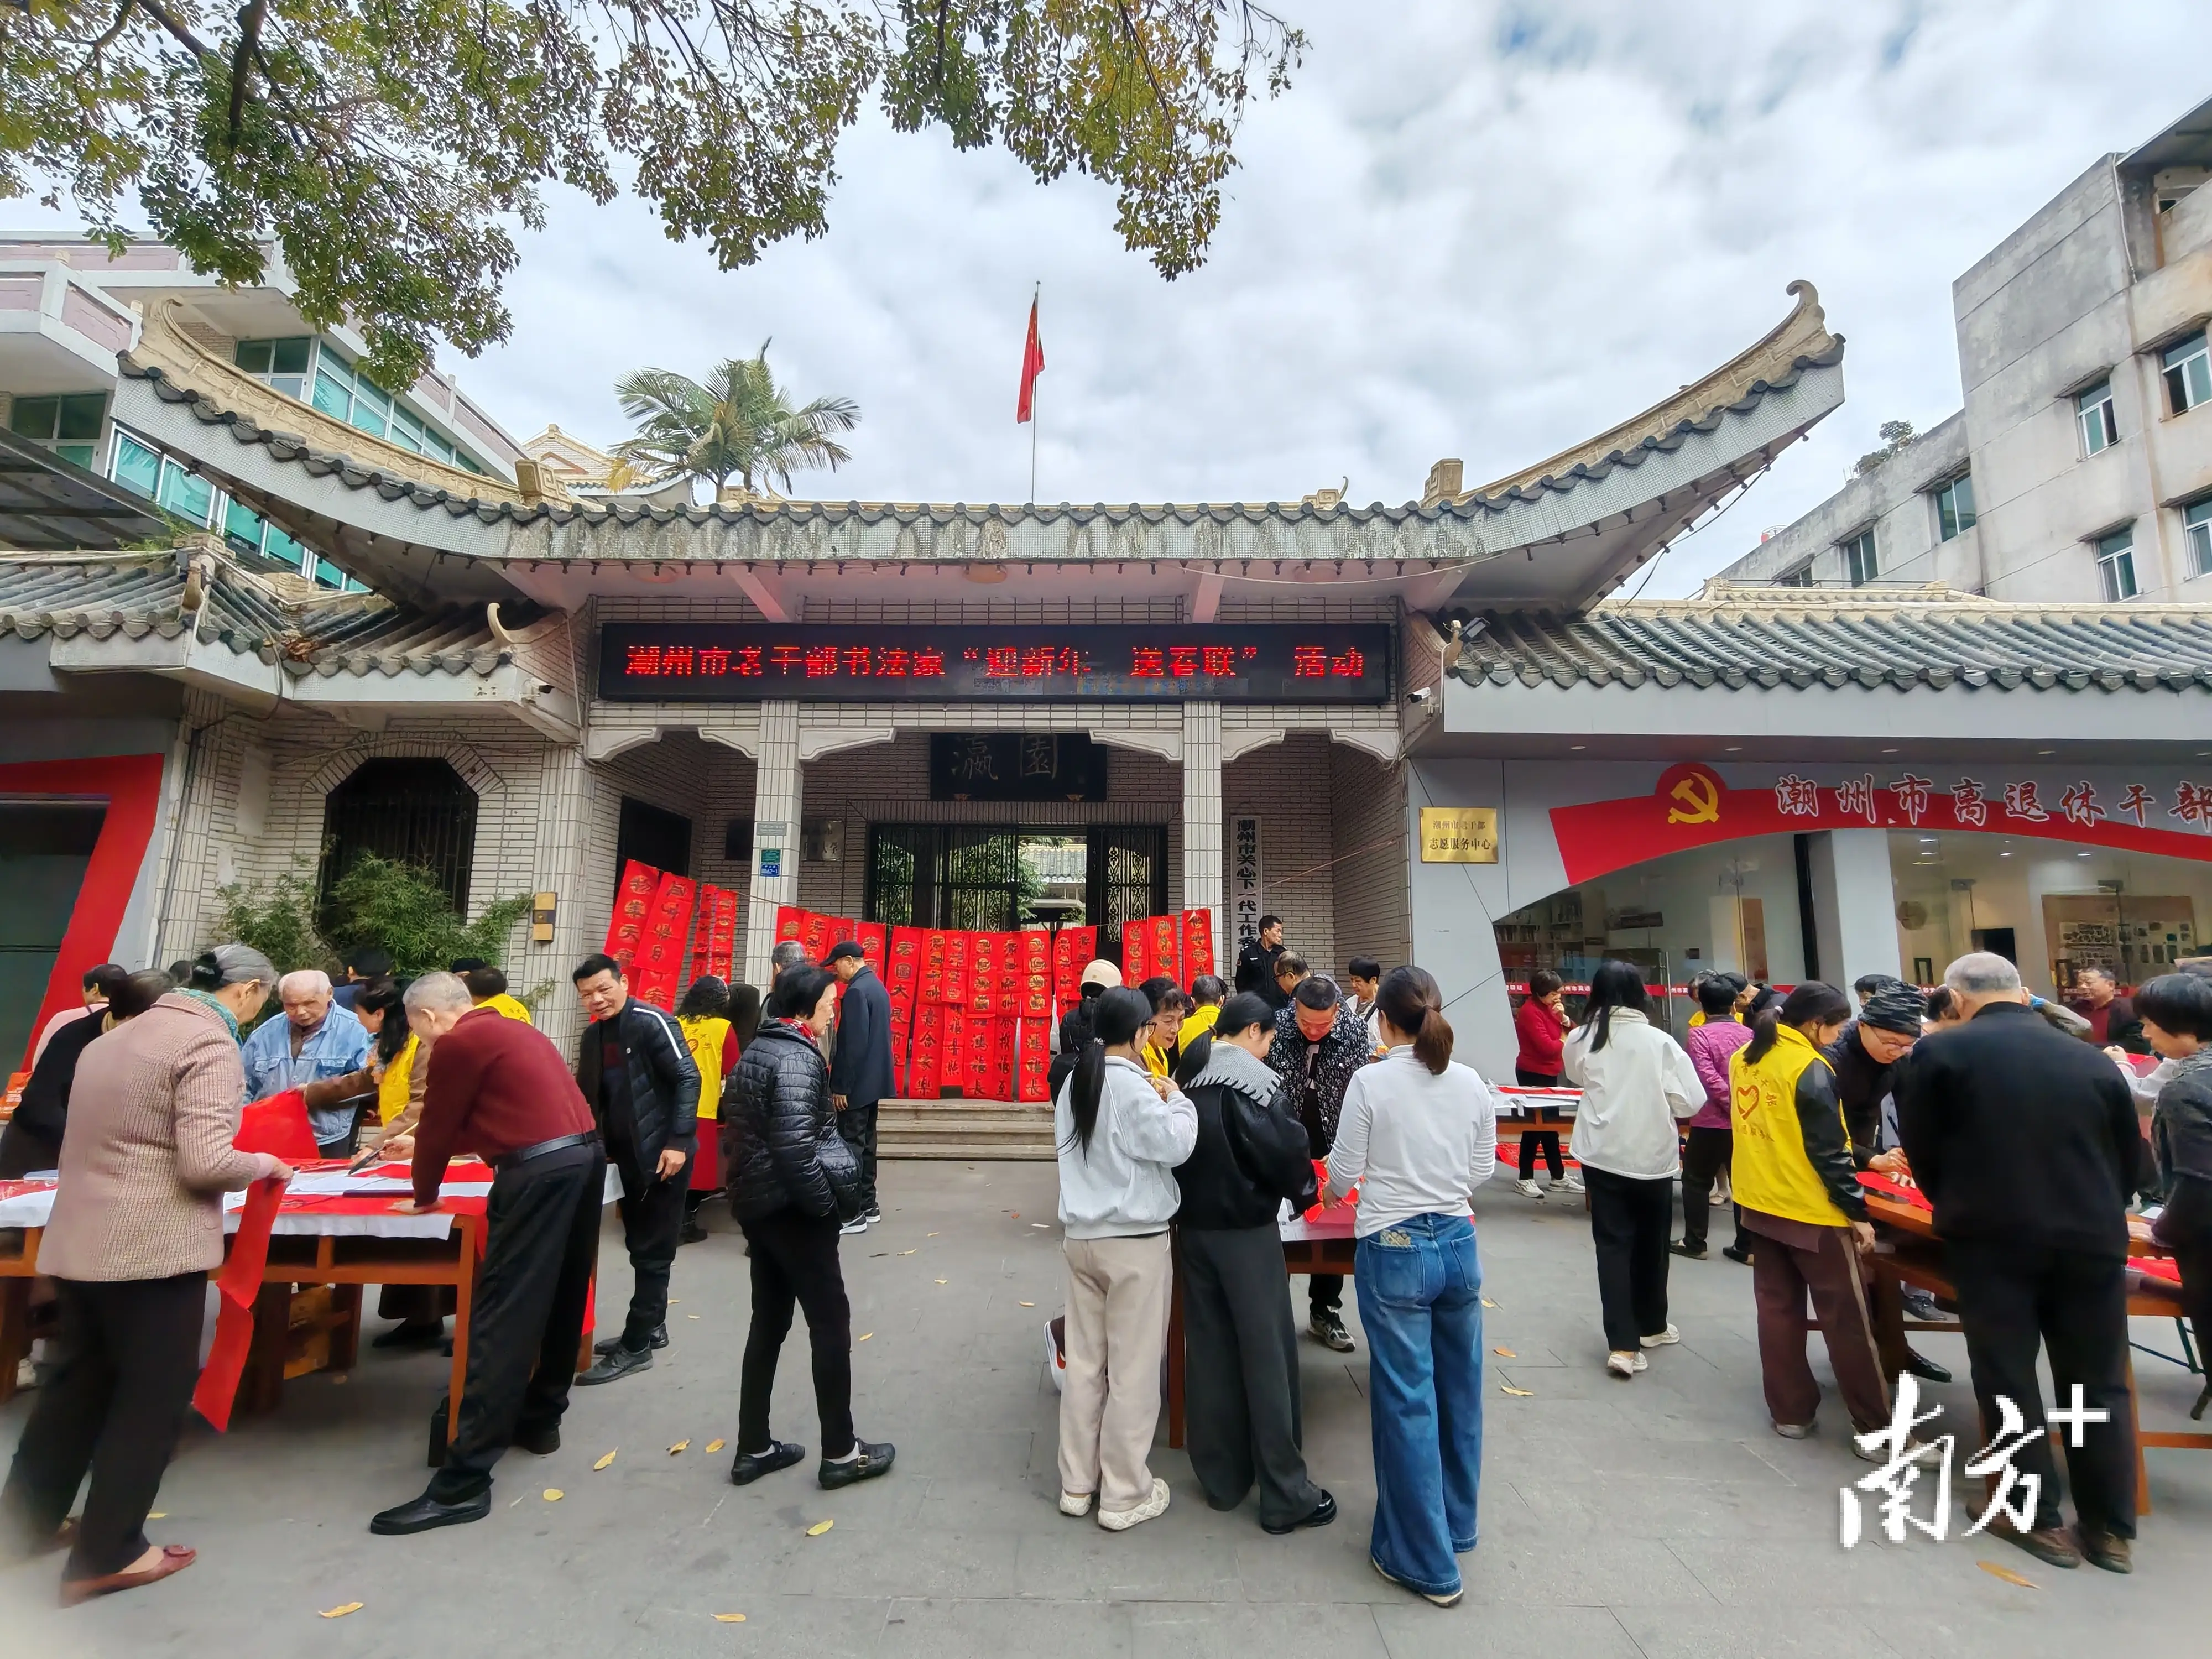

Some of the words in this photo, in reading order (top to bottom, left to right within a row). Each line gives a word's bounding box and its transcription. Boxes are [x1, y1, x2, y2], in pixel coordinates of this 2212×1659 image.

[1294, 645, 1365, 677] 活动
[1429, 837, 1491, 851] 志愿服务中心
